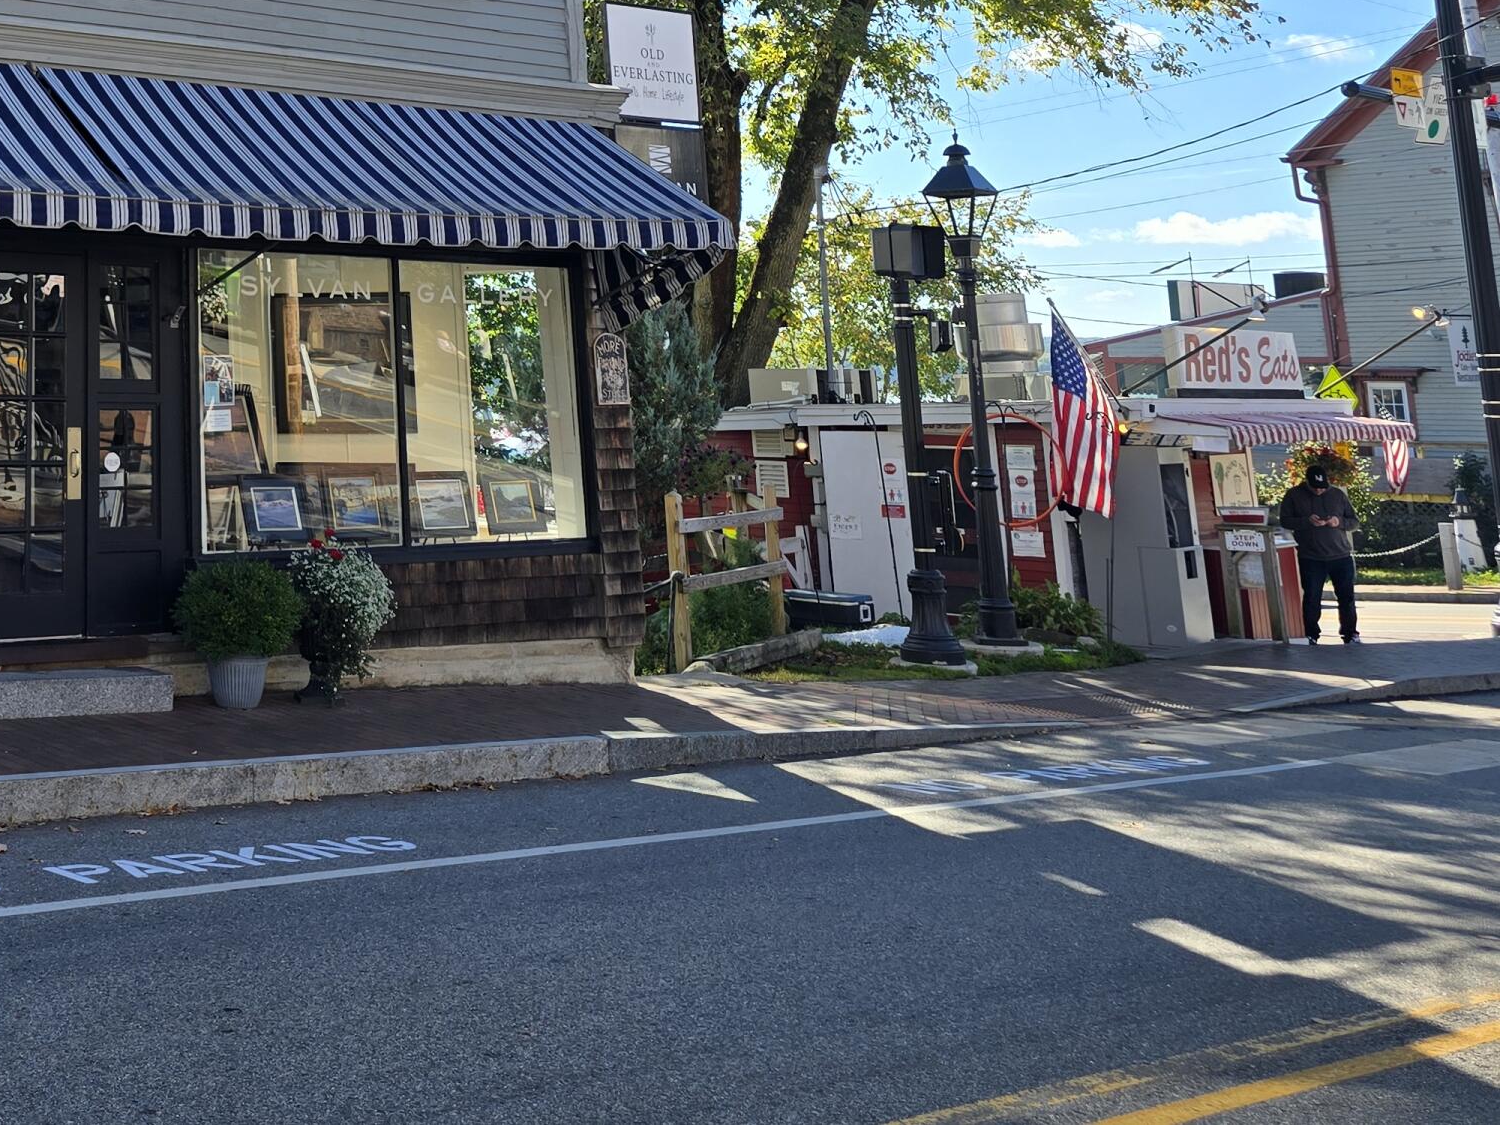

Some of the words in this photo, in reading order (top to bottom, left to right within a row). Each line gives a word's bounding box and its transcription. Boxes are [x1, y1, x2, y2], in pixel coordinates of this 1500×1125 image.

[640, 47, 665, 60] OLD
[613, 65, 694, 85] EVERLASTING
[241, 275, 371, 300] SYLVAN
[419, 283, 554, 307] GALLERY
[595, 340, 621, 356] MORE
[1183, 334, 1252, 384] Red's
[1257, 337, 1299, 385] Eats
[1231, 540, 1259, 548] DOWN
[879, 779, 986, 794] NO
[980, 755, 1211, 784] PARKING
[42, 834, 418, 884] PARKING
